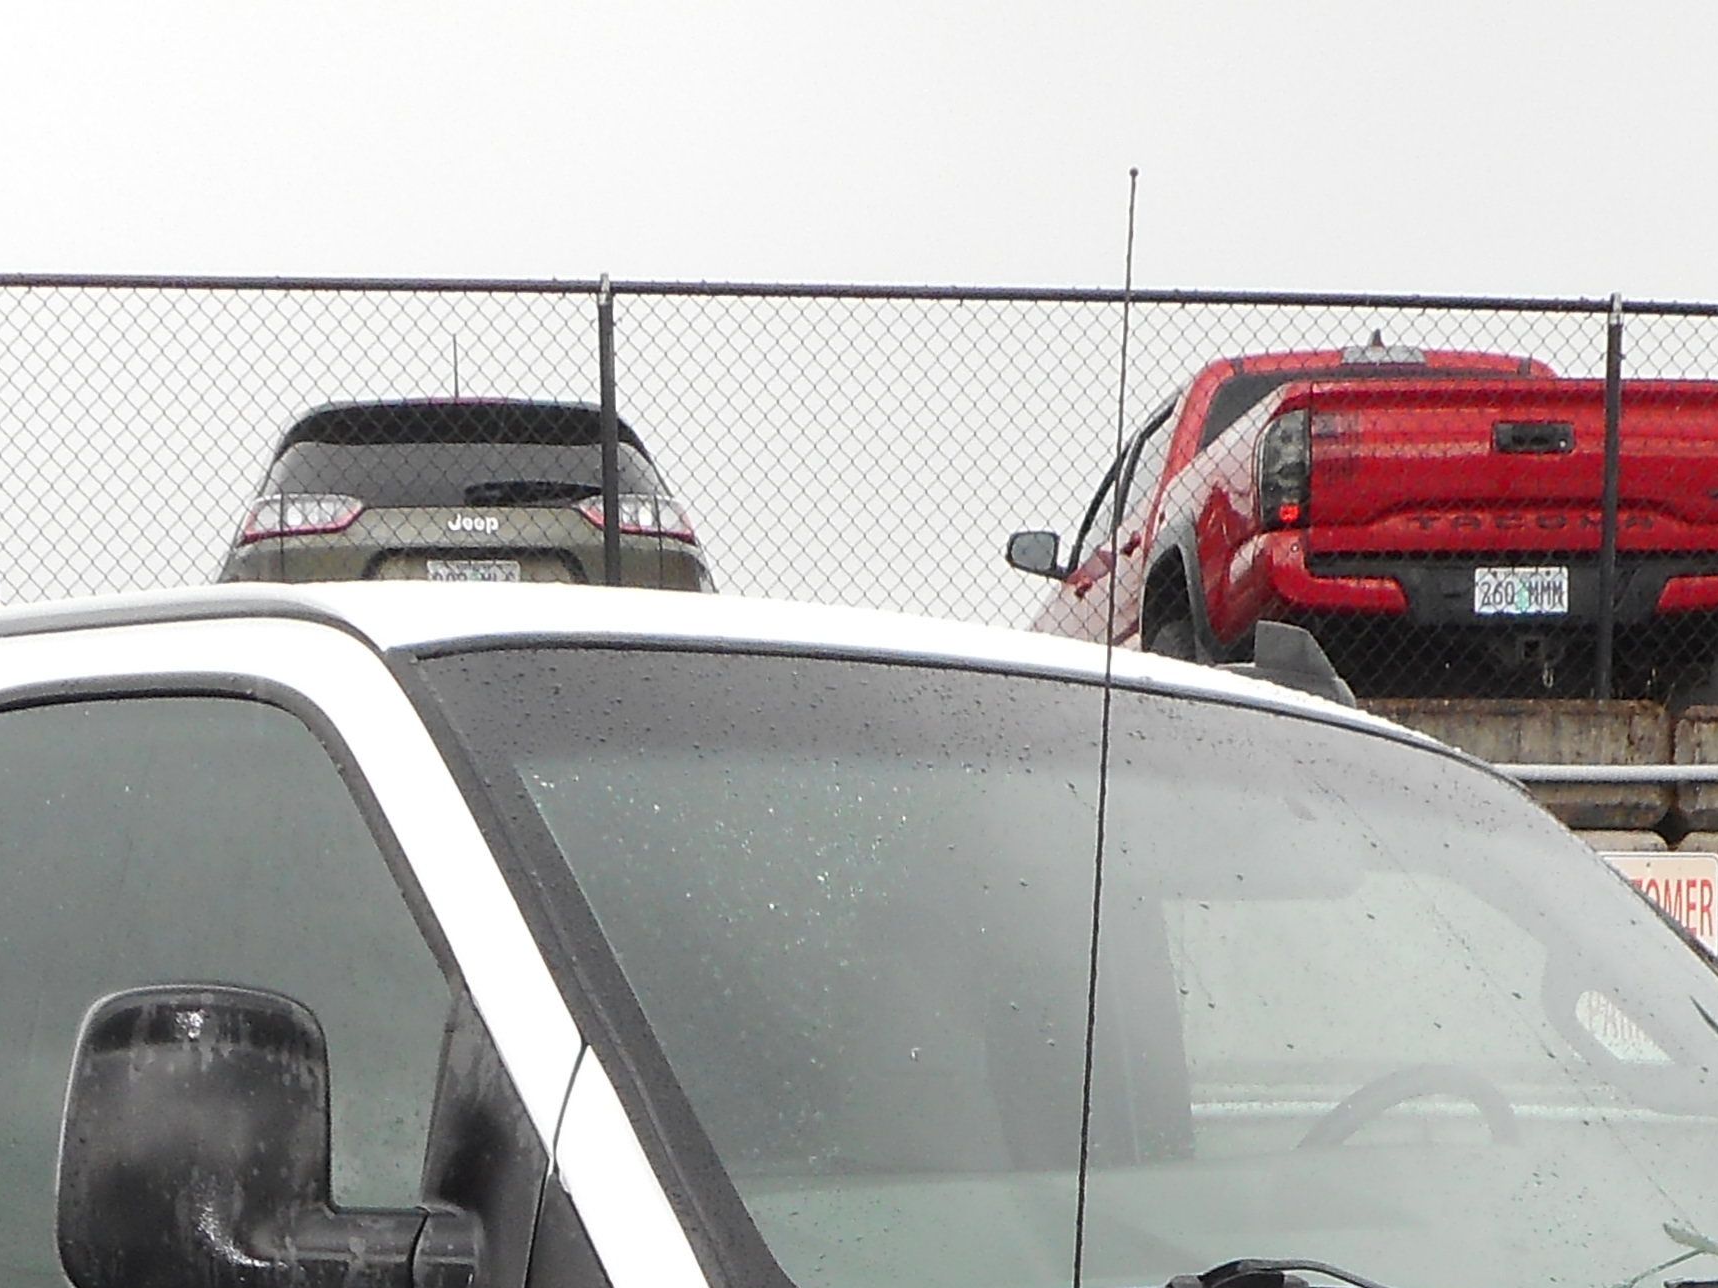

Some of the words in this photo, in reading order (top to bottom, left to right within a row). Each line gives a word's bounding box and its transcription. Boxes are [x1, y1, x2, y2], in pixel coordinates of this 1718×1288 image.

[447, 513, 500, 535] Jeep
[1412, 514, 1654, 531] TACOMA
[1479, 581, 1517, 606] 260
